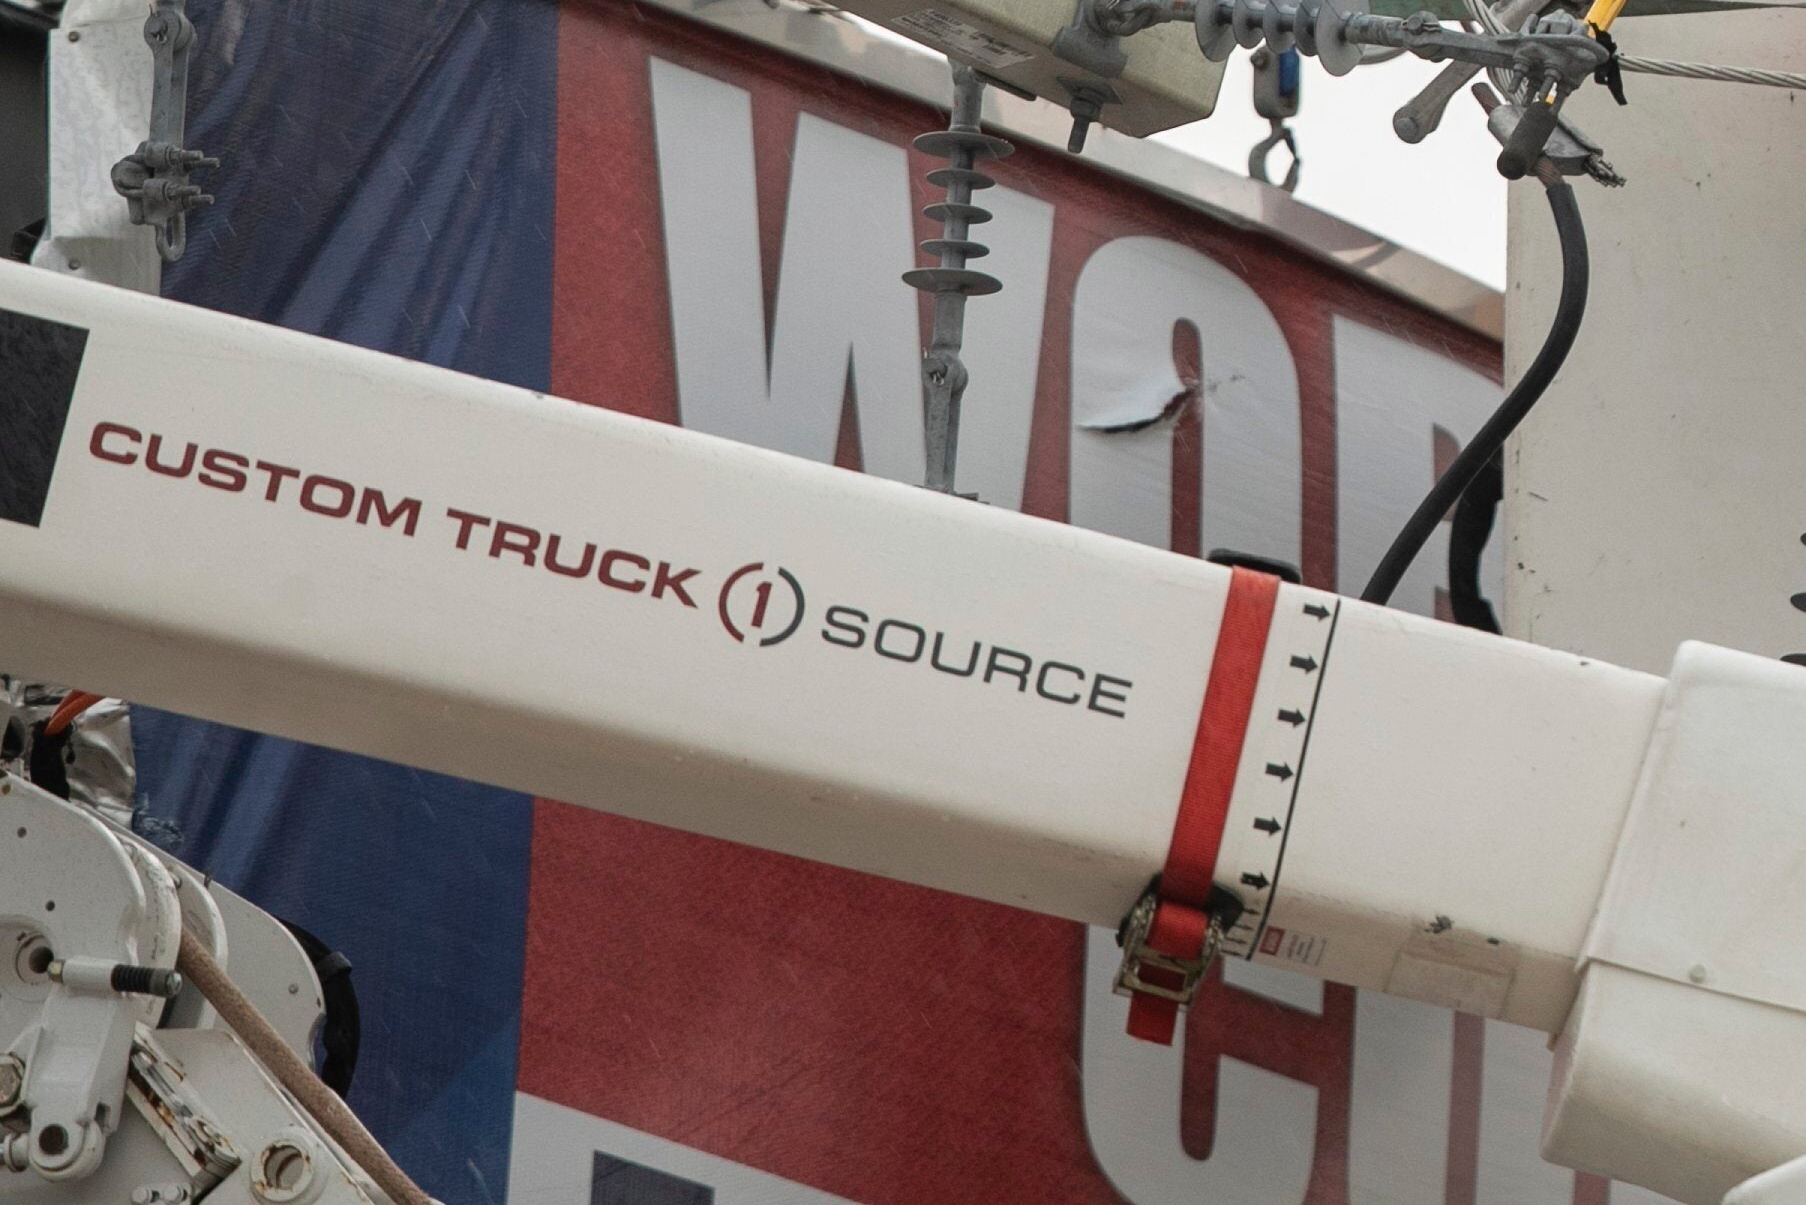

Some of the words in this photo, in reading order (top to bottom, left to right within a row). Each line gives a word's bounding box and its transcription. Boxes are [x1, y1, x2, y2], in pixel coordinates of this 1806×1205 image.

[89, 421, 422, 537] CUSTOM
[446, 508, 702, 608] TRUCK
[821, 625, 1133, 719] SOURCE
